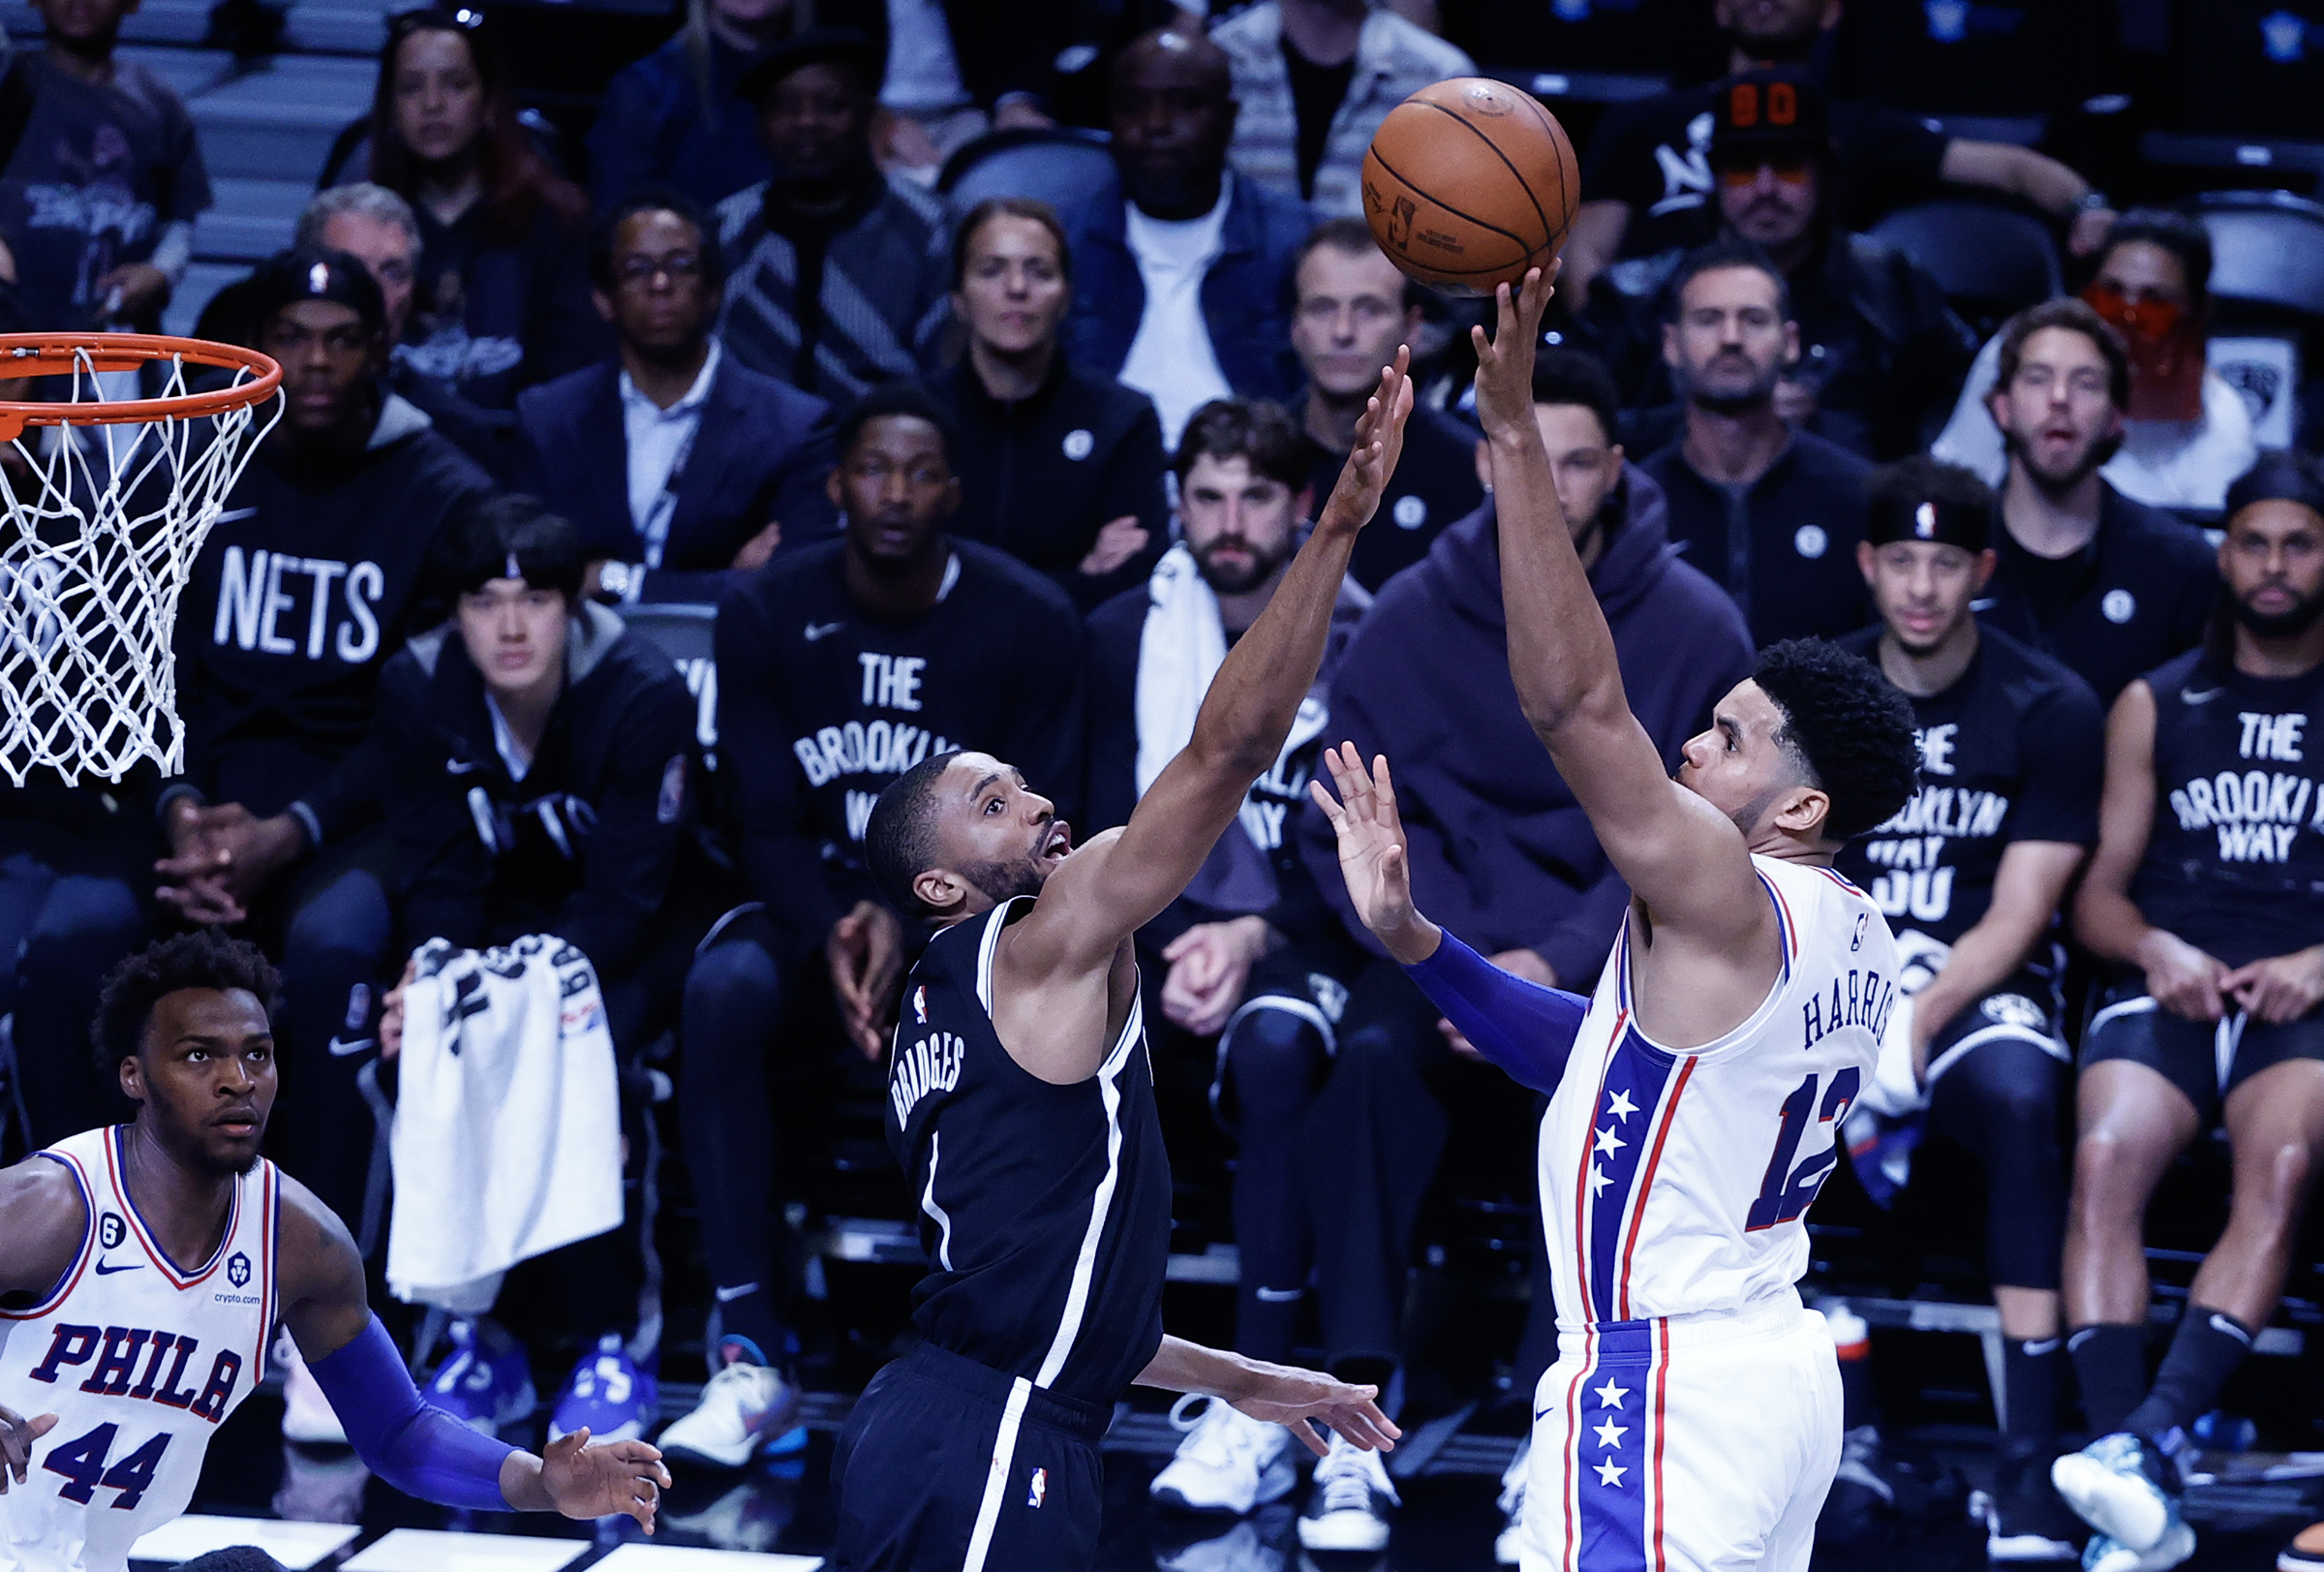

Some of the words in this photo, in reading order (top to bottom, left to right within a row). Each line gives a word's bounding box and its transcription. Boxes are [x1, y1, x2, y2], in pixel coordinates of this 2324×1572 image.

[213, 544, 385, 664] NETS
[858, 651, 927, 712] THE
[1911, 723, 1959, 776] HE
[2237, 711, 2309, 762] THE
[2217, 822, 2298, 864] WAY
[1803, 970, 1893, 1051] HARRIS
[891, 1031, 965, 1133] BRIDGES
[1745, 1066, 1860, 1232] 12
[102, 1217, 119, 1247] 6
[214, 1293, 260, 1306] crypto.com
[29, 1323, 242, 1424] PHILA
[42, 1421, 173, 1510] 44
